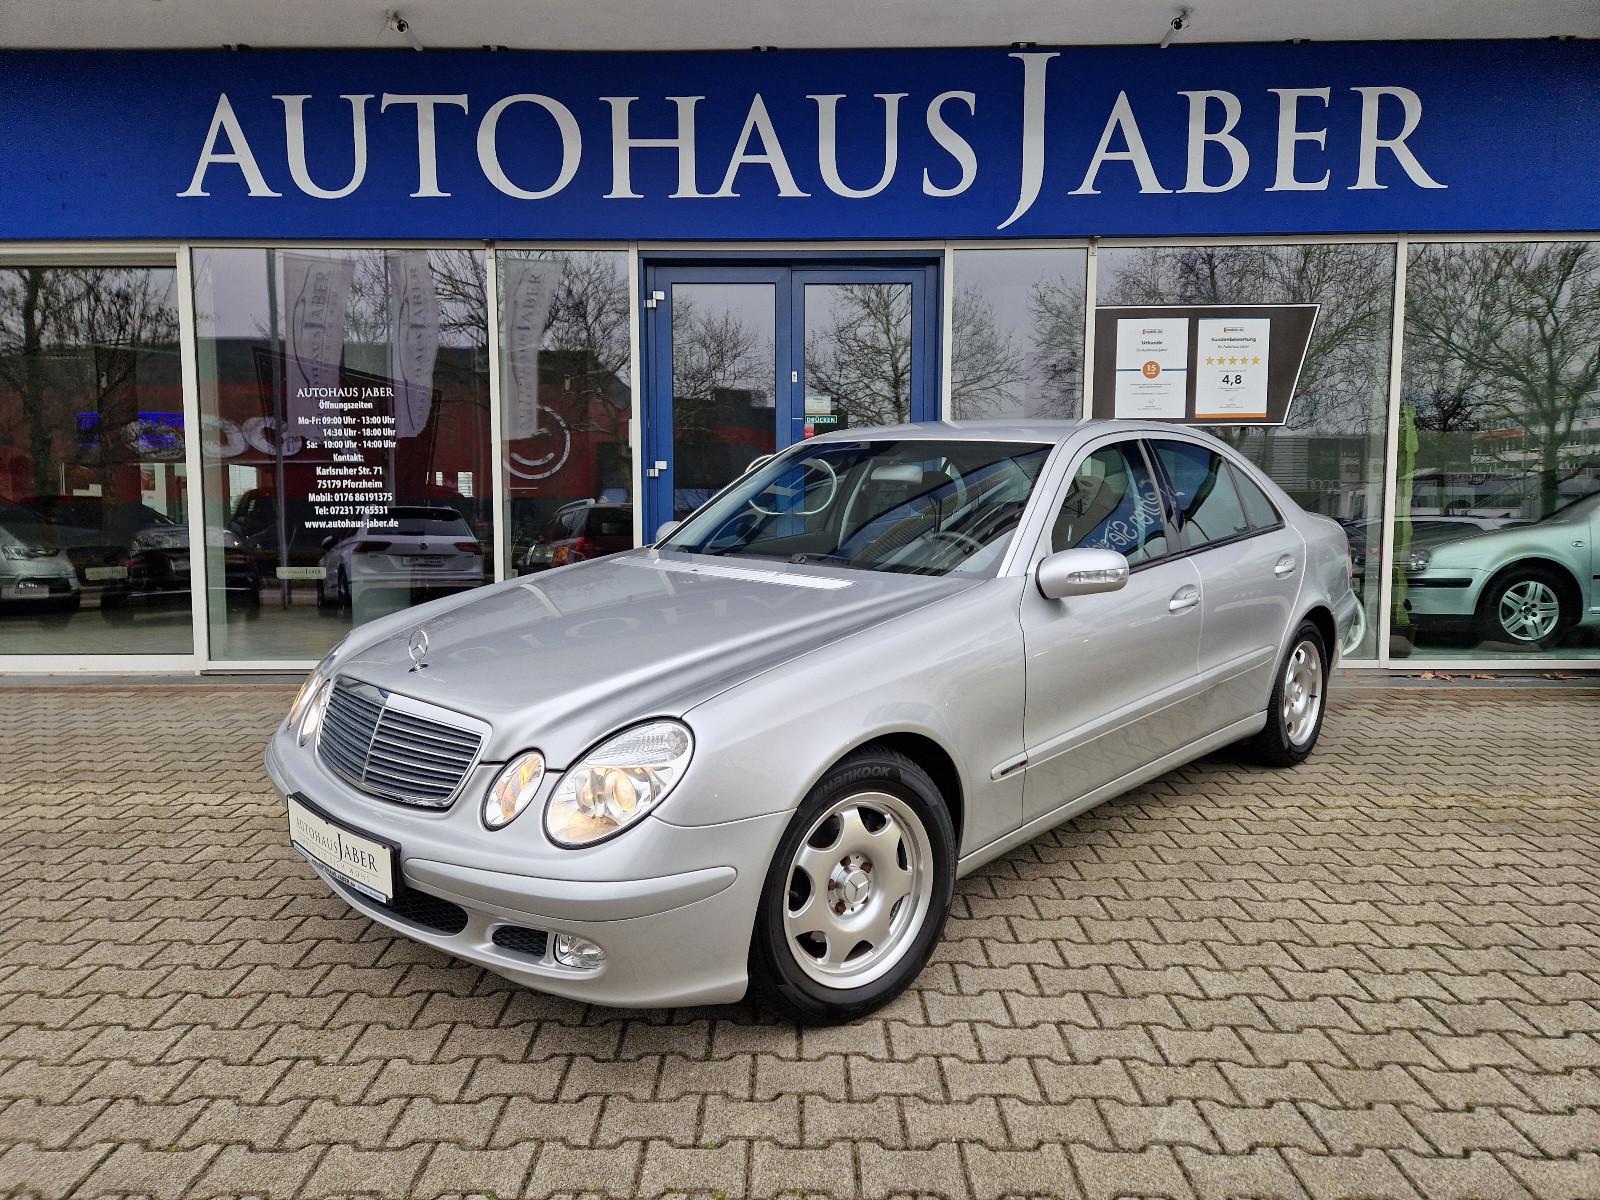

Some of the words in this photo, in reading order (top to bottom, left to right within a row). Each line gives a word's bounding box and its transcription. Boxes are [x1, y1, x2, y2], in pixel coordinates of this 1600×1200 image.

[176, 92, 979, 201] AUTOHAUS
[997, 52, 1448, 229] JABER
[1146, 364, 1157, 372] 15
[1222, 374, 1242, 386] 4,8
[297, 387, 359, 398] AUTOHAUS
[361, 387, 394, 399] JABER
[319, 400, 373, 411] Öffnungszeiten
[298, 416, 321, 425] Mo-Fr:
[322, 416, 341, 424] 09:00
[343, 416, 356, 424] Uhr
[362, 416, 381, 424] 13:00
[382, 416, 395, 424] Uhr
[323, 428, 341, 437] 14:30
[343, 428, 356, 437] Uhr
[362, 428, 381, 436] 18:00
[383, 428, 396, 436] Uhr
[306, 441, 318, 449] Sa:
[324, 441, 343, 449] 10:00
[345, 441, 357, 449] Uhr
[363, 440, 381, 448] 14:00
[383, 440, 396, 448] Uhr
[333, 453, 364, 462] Kontakt:
[316, 466, 357, 475] Karlsruher
[358, 466, 372, 475] Str.
[373, 466, 383, 475] 71
[317, 480, 341, 488] 75179
[342, 479, 383, 489] Pforzheim
[308, 493, 333, 502] Mobil:
[334, 493, 354, 501] 0176
[355, 493, 393, 502] 86191375
[314, 506, 329, 515] Tel:
[329, 506, 354, 515] 07231
[355, 506, 388, 514] 7765531
[305, 518, 399, 529] www.autohaus-jaber.de
[296, 817, 338, 854] AUTOHAUS
[337, 832, 378, 872] JABER
